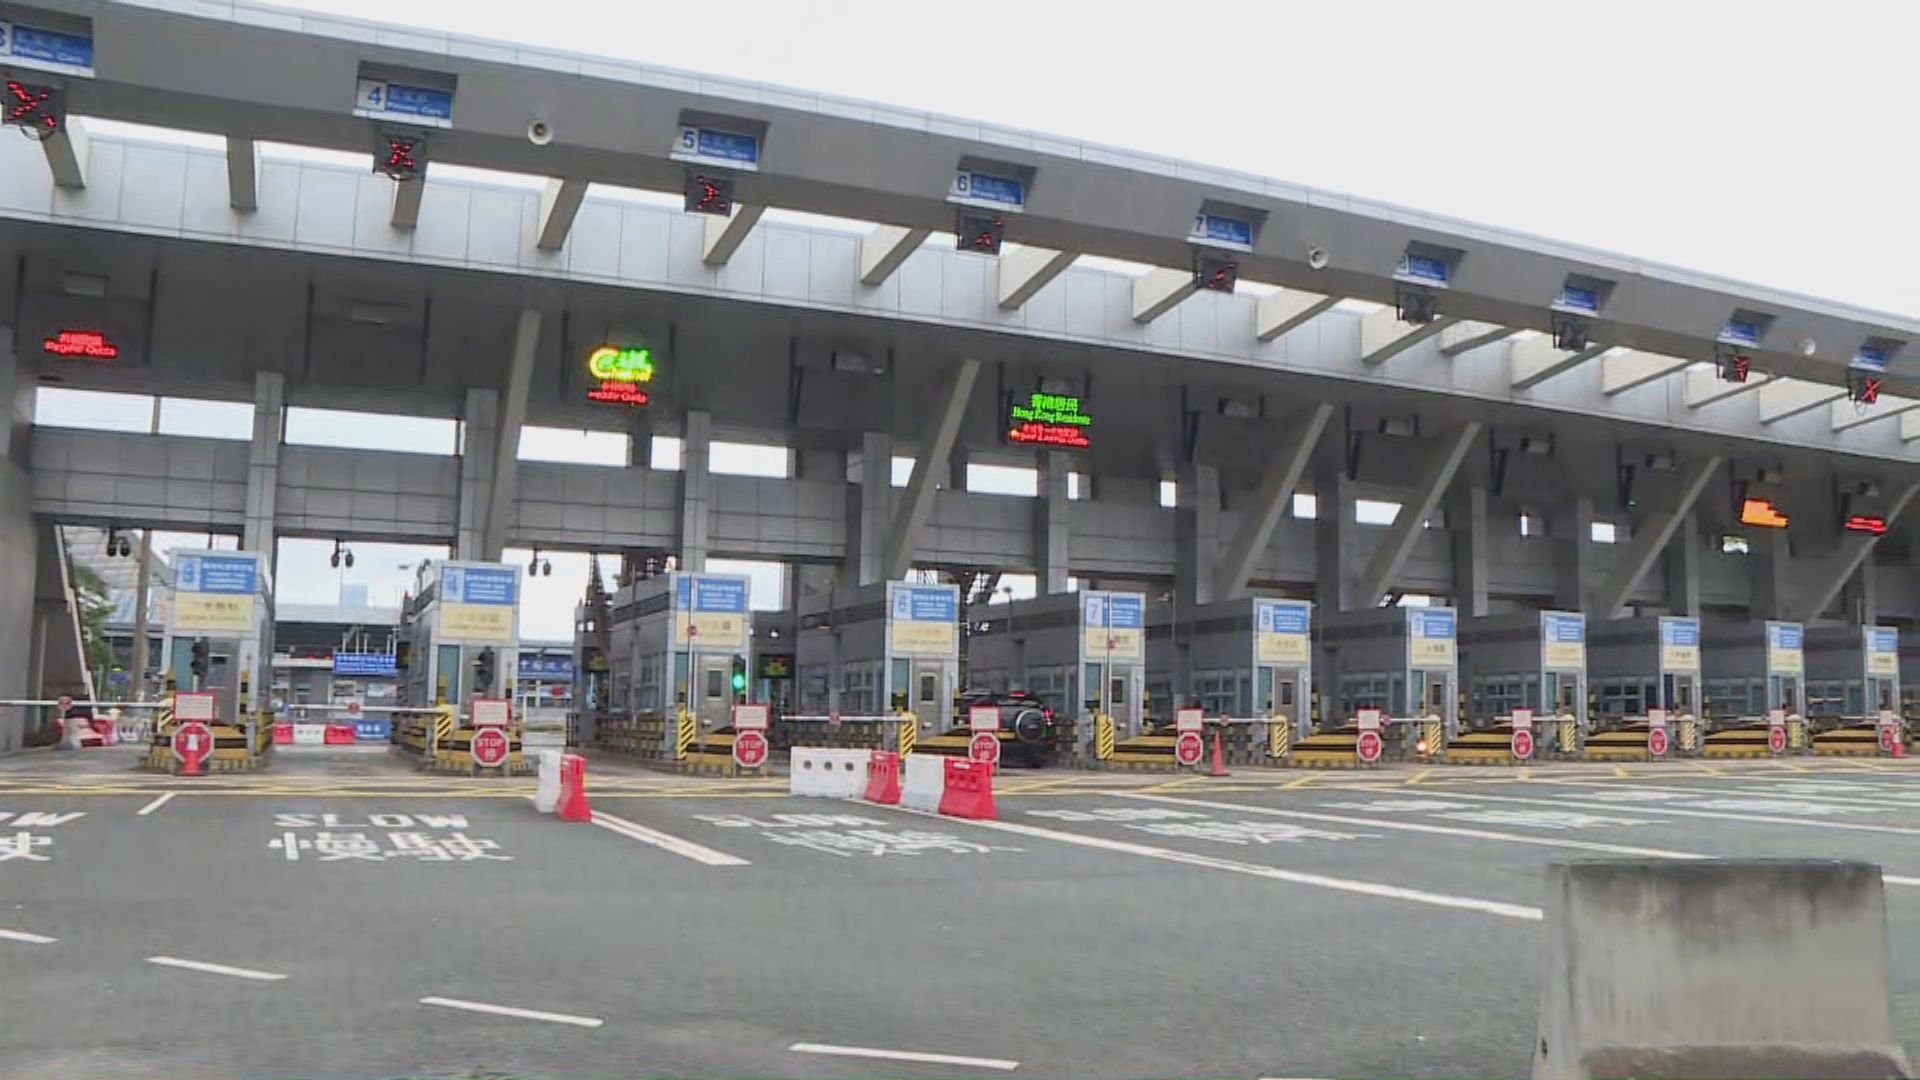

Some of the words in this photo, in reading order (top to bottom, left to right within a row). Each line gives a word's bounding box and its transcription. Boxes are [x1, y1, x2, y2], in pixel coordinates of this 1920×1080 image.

[367, 86, 382, 105] 4
[683, 130, 695, 149] 5
[957, 175, 967, 192] 6
[1195, 215, 1204, 232] 7
[1013, 406, 1034, 421] Hong
[1034, 409, 1056, 424] Kong
[1090, 604, 1097, 620] 7
[477, 738, 504, 747] STOP
[738, 740, 762, 750] STOP
[974, 742, 996, 751] STOP
[274, 814, 469, 827] SLOW
[268, 832, 515, 861] 慢駛
